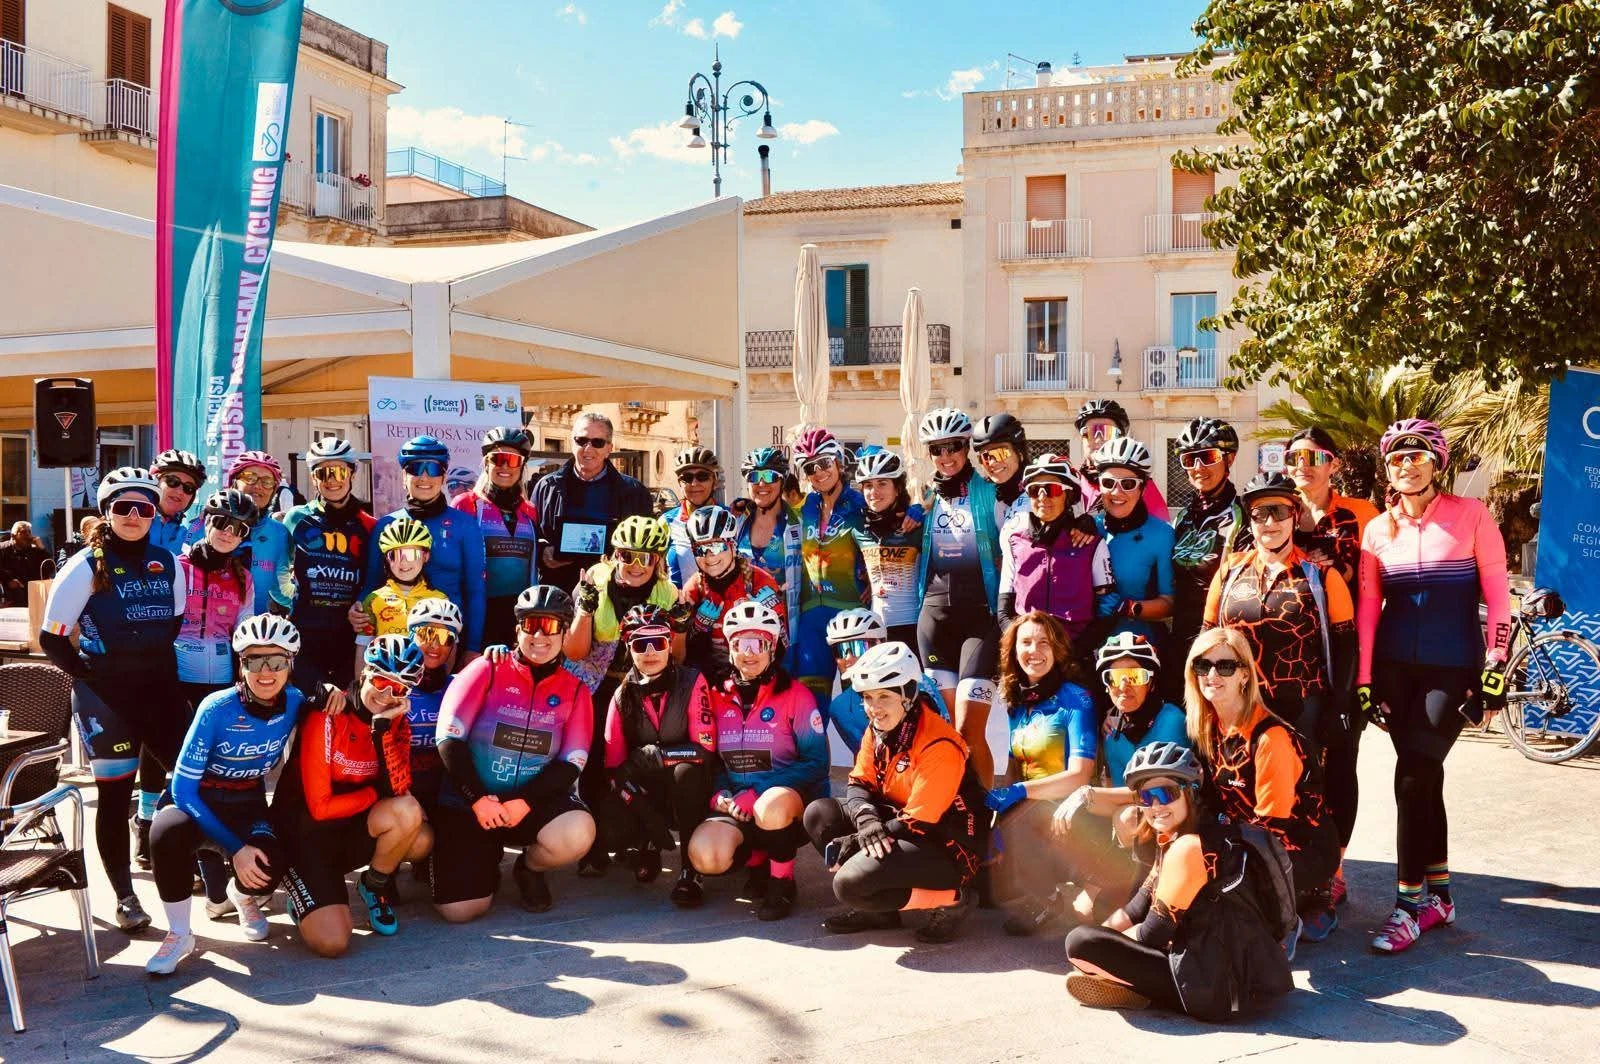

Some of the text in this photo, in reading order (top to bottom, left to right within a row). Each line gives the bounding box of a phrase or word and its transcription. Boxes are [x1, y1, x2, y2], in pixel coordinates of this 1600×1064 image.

[243, 167, 278, 265] CYCLING
[432, 399, 459, 407] SPORT
[386, 424, 422, 439] RETE
[425, 428, 462, 441] ROSA
[1494, 622, 1510, 649] TECH
[503, 734, 525, 743] PAOLO
[295, 878, 316, 908] MONTE
